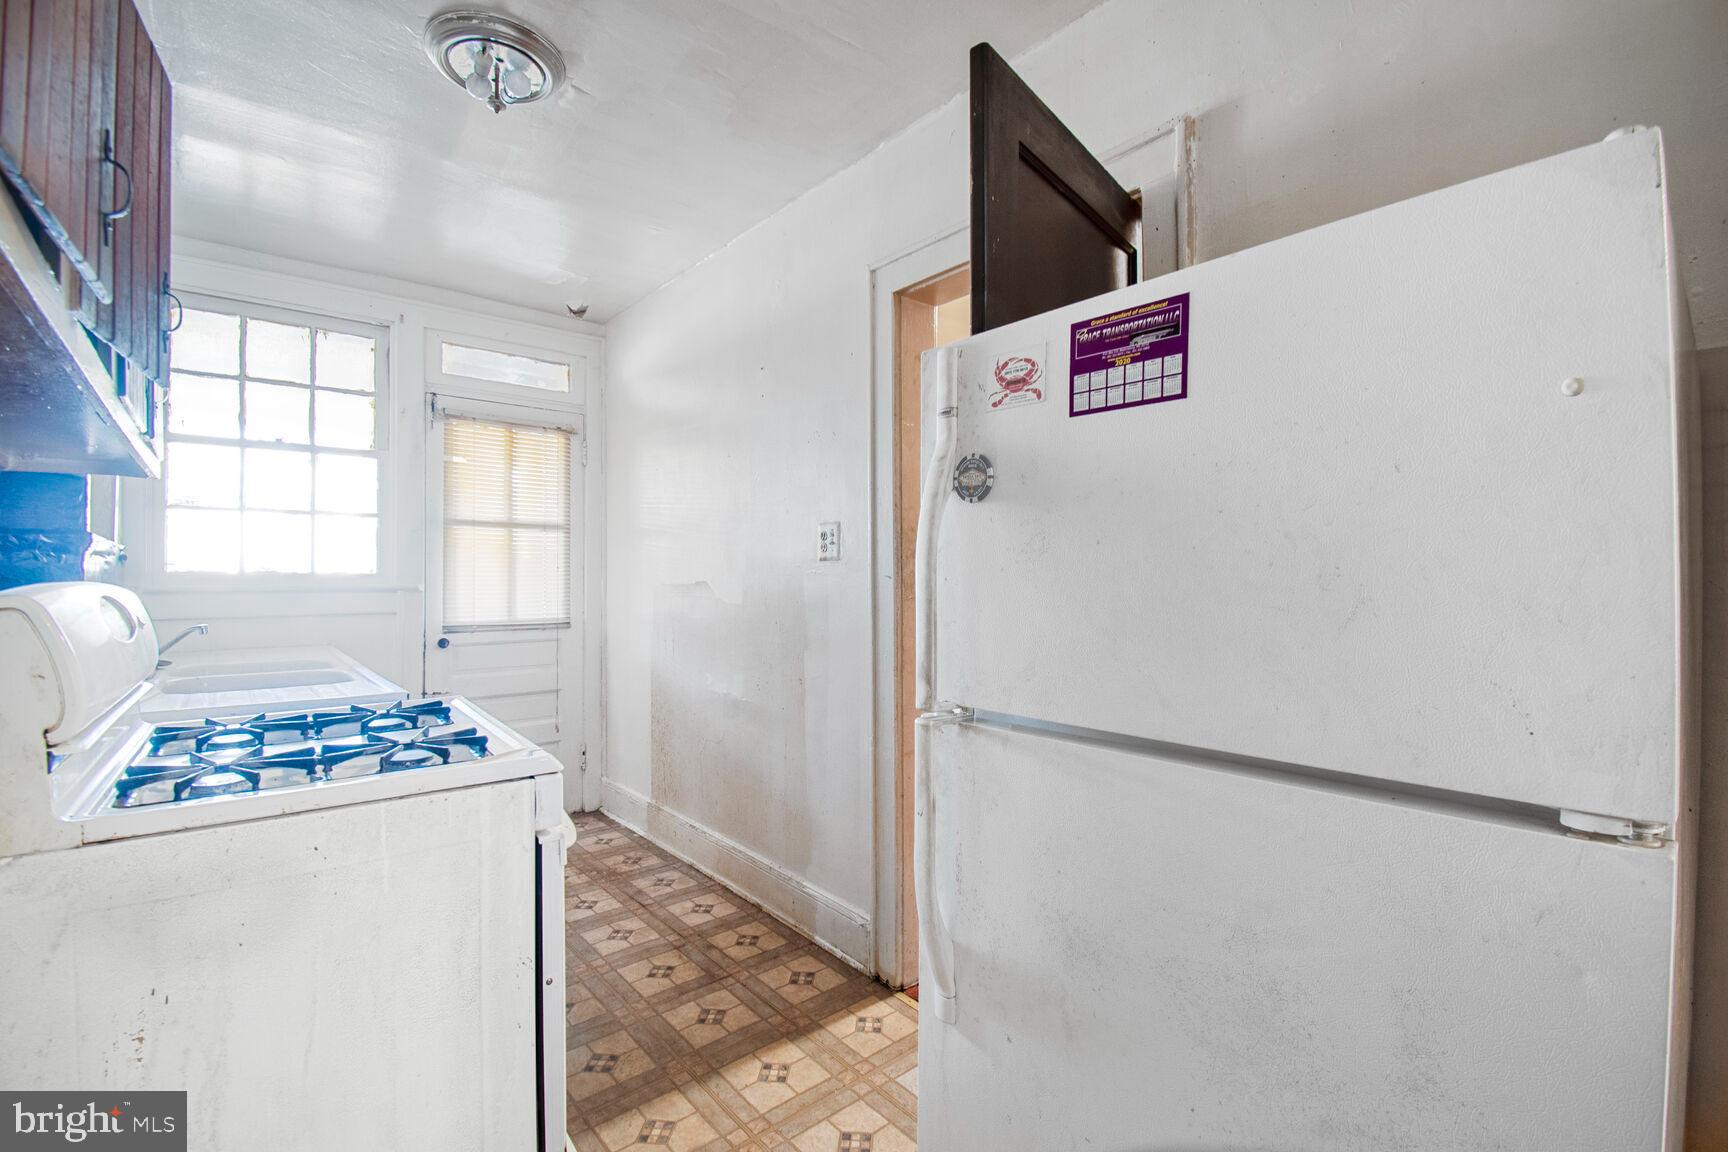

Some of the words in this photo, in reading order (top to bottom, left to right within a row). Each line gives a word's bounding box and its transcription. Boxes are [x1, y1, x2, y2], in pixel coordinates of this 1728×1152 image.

[1109, 311, 1131, 321] standard
[1102, 314, 1164, 338] TRANSPORTATION
[1164, 310, 1180, 323] LLC
[1115, 358, 1131, 366] 2020
